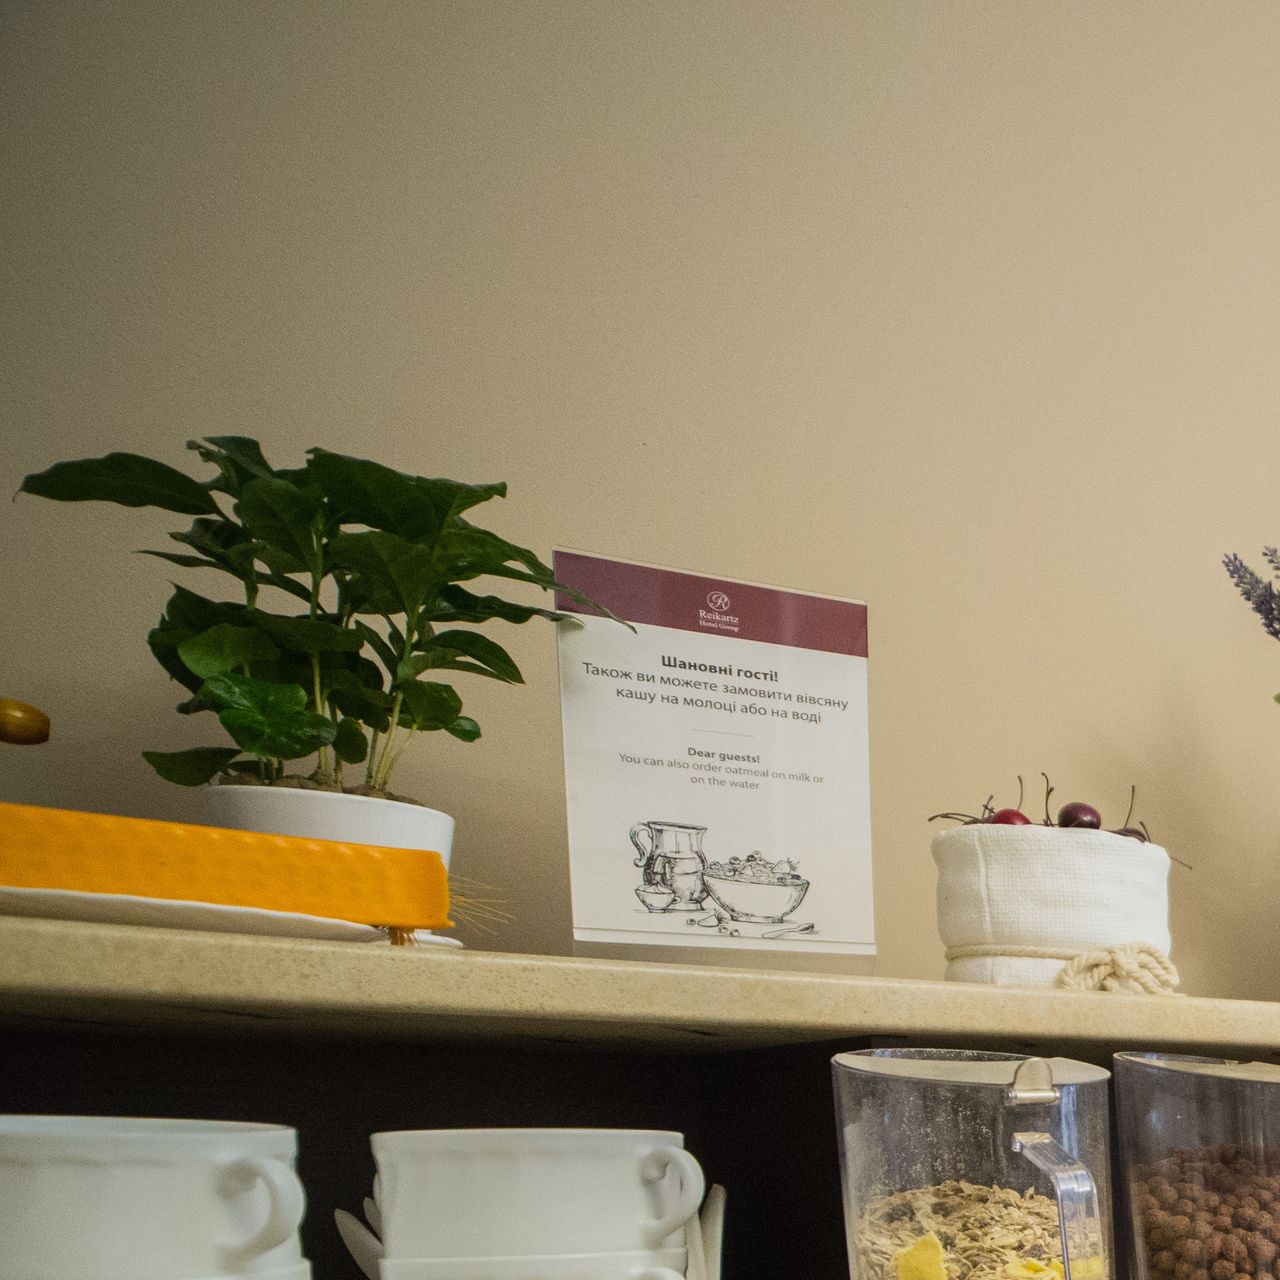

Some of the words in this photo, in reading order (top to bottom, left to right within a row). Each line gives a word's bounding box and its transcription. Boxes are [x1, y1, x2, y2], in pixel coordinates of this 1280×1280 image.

[699, 609, 739, 624] Reikartz
[700, 620, 718, 629] Hotel
[719, 624, 740, 632] Group
[661, 655, 733, 676] Шановні
[737, 668, 779, 682] гості!
[582, 662, 632, 680] Також
[636, 673, 655, 683] ви
[660, 676, 718, 692] можете
[722, 684, 792, 702] замовити
[797, 693, 849, 711] вівсяну
[616, 688, 656, 704] кашу
[661, 694, 679, 705] на
[683, 697, 737, 713] молоці
[740, 703, 767, 717] або
[771, 708, 788, 719] на
[792, 711, 822, 724] воді
[687, 747, 715, 758] Dear
[719, 752, 760, 764] guests!
[618, 753, 640, 764] You
[644, 758, 664, 767] can
[667, 759, 689, 769] also
[692, 762, 722, 773] order
[725, 766, 769, 778] oatmeal
[772, 772, 786, 780] on
[789, 773, 810, 783] milk
[690, 776, 705, 785] on
[708, 777, 726, 786] the
[729, 780, 760, 790] water
